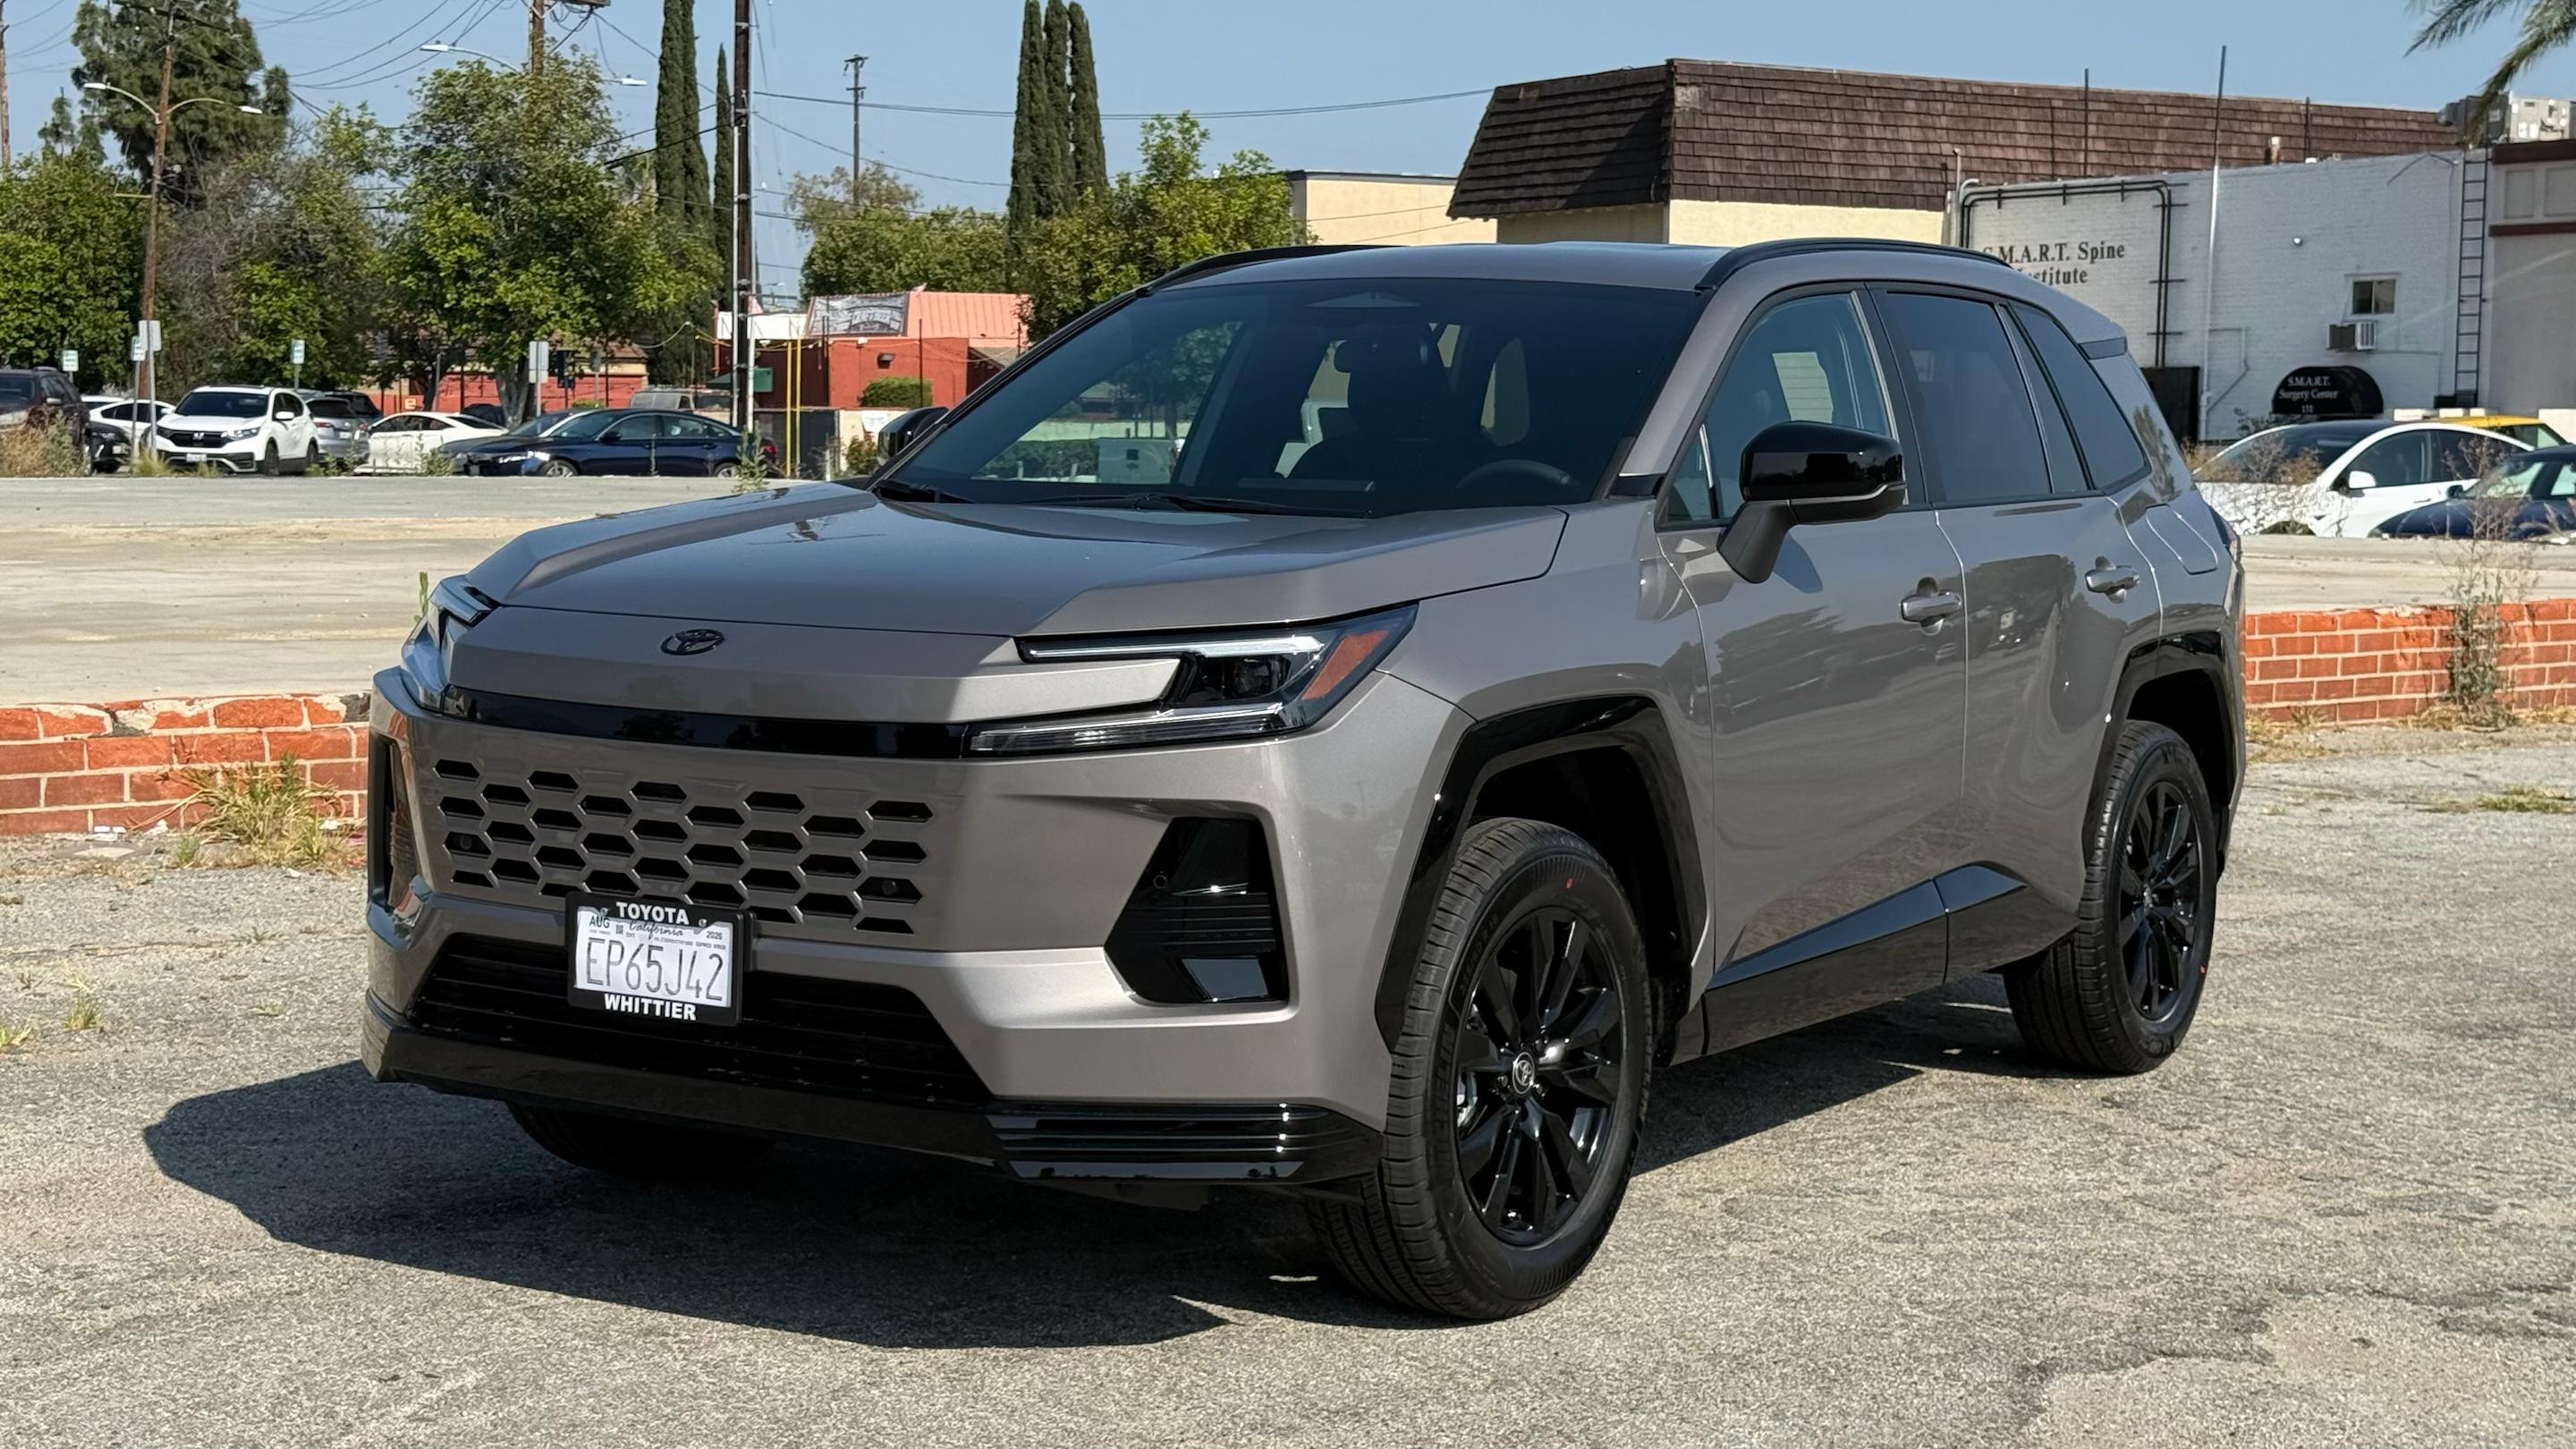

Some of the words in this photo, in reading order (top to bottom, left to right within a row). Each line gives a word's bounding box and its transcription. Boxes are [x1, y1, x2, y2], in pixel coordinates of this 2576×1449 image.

[1982, 242, 2071, 265] M.A.R.T.
[2077, 241, 2125, 265] Spine
[2016, 267, 2089, 286] stitute
[2287, 376, 2331, 386] S.M.A.R.T.
[2278, 388, 2309, 401] Surgery
[2310, 388, 2339, 399] Center
[589, 915, 610, 928] AUG
[616, 902, 690, 925] TOYOTA
[629, 919, 684, 939] California
[587, 936, 723, 1001] EP65J42
[604, 993, 697, 1021] WHITTIER
